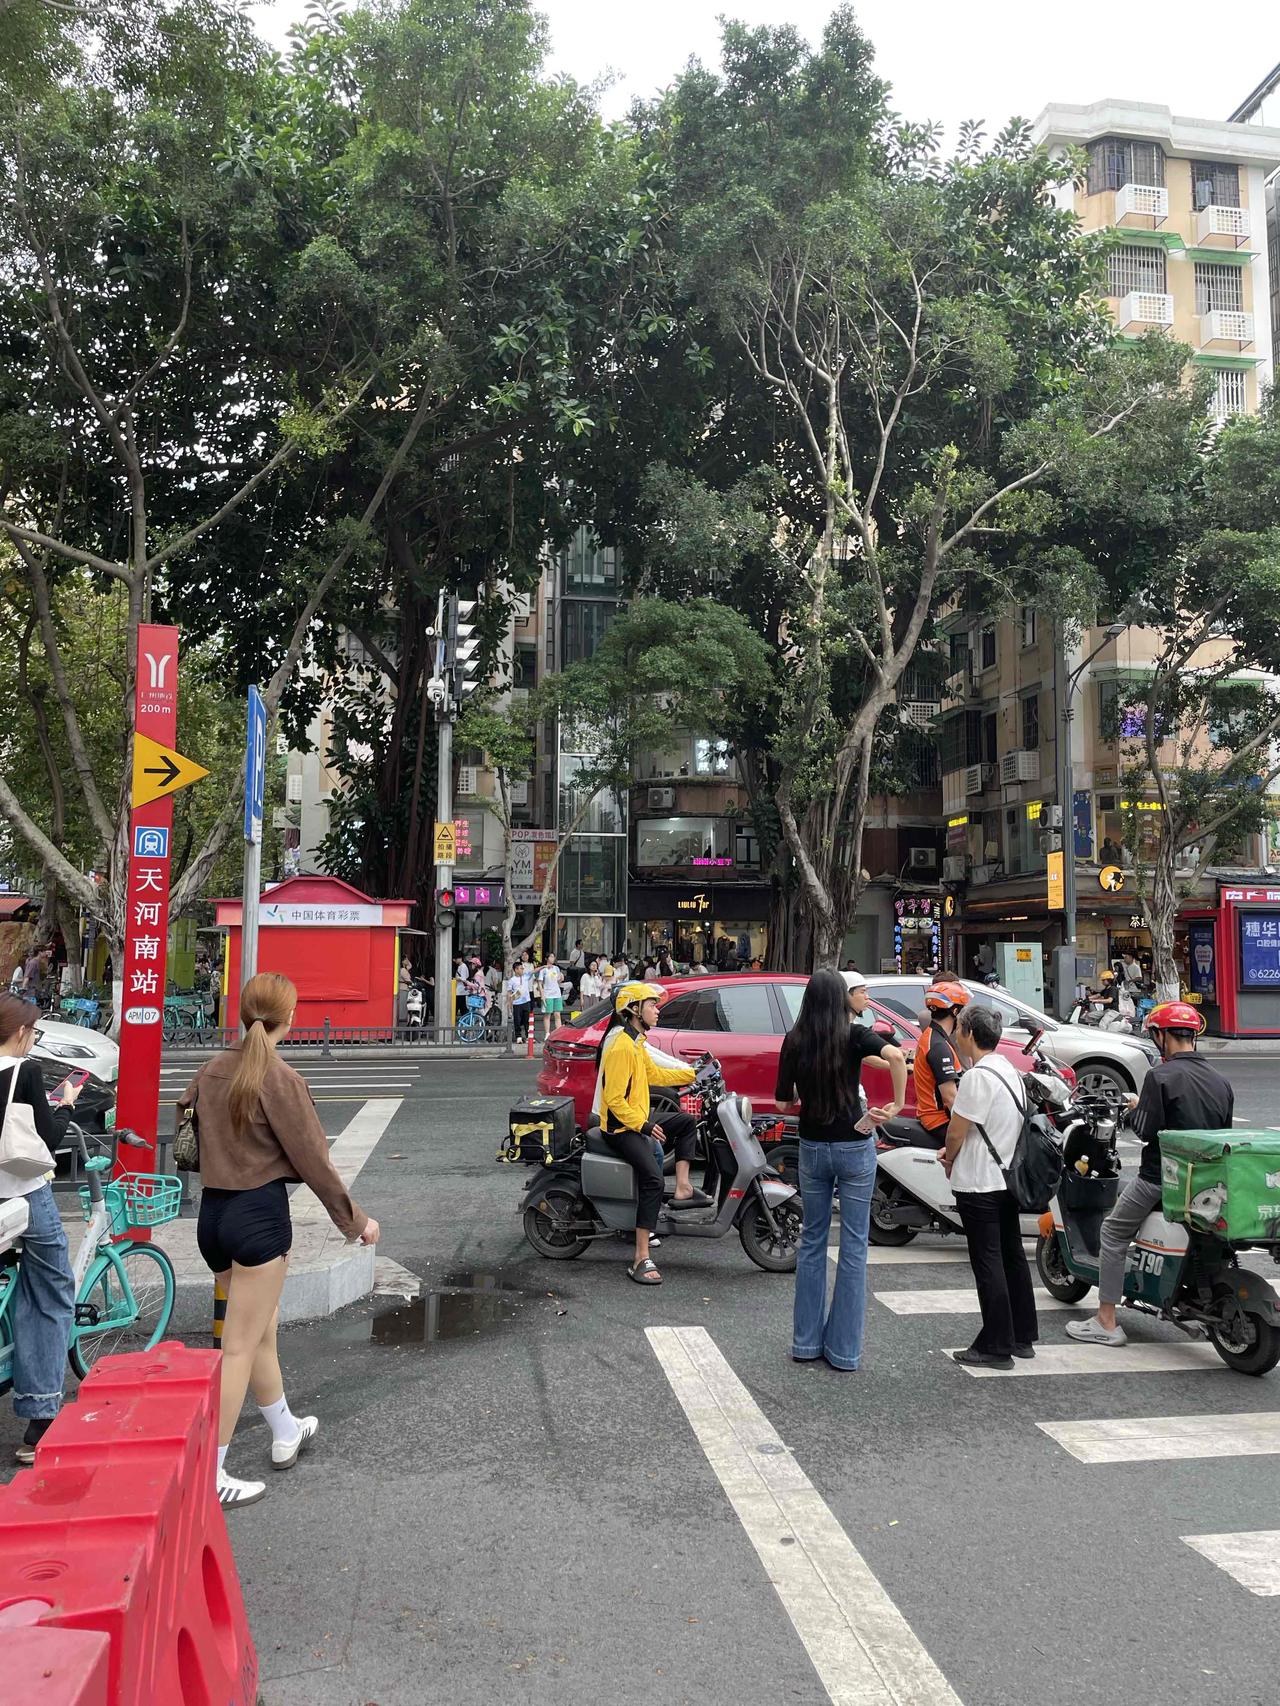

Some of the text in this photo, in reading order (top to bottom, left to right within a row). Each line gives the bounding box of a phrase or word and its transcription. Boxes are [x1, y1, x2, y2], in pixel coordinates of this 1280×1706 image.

[512, 830, 530, 838] POP
[512, 860, 531, 869] YM
[291, 909, 361, 921] 中国体育彩票
[130, 868, 163, 994] 天河南站
[1245, 921, 1280, 937] 穗华
[128, 1010, 157, 1021] APM 07
